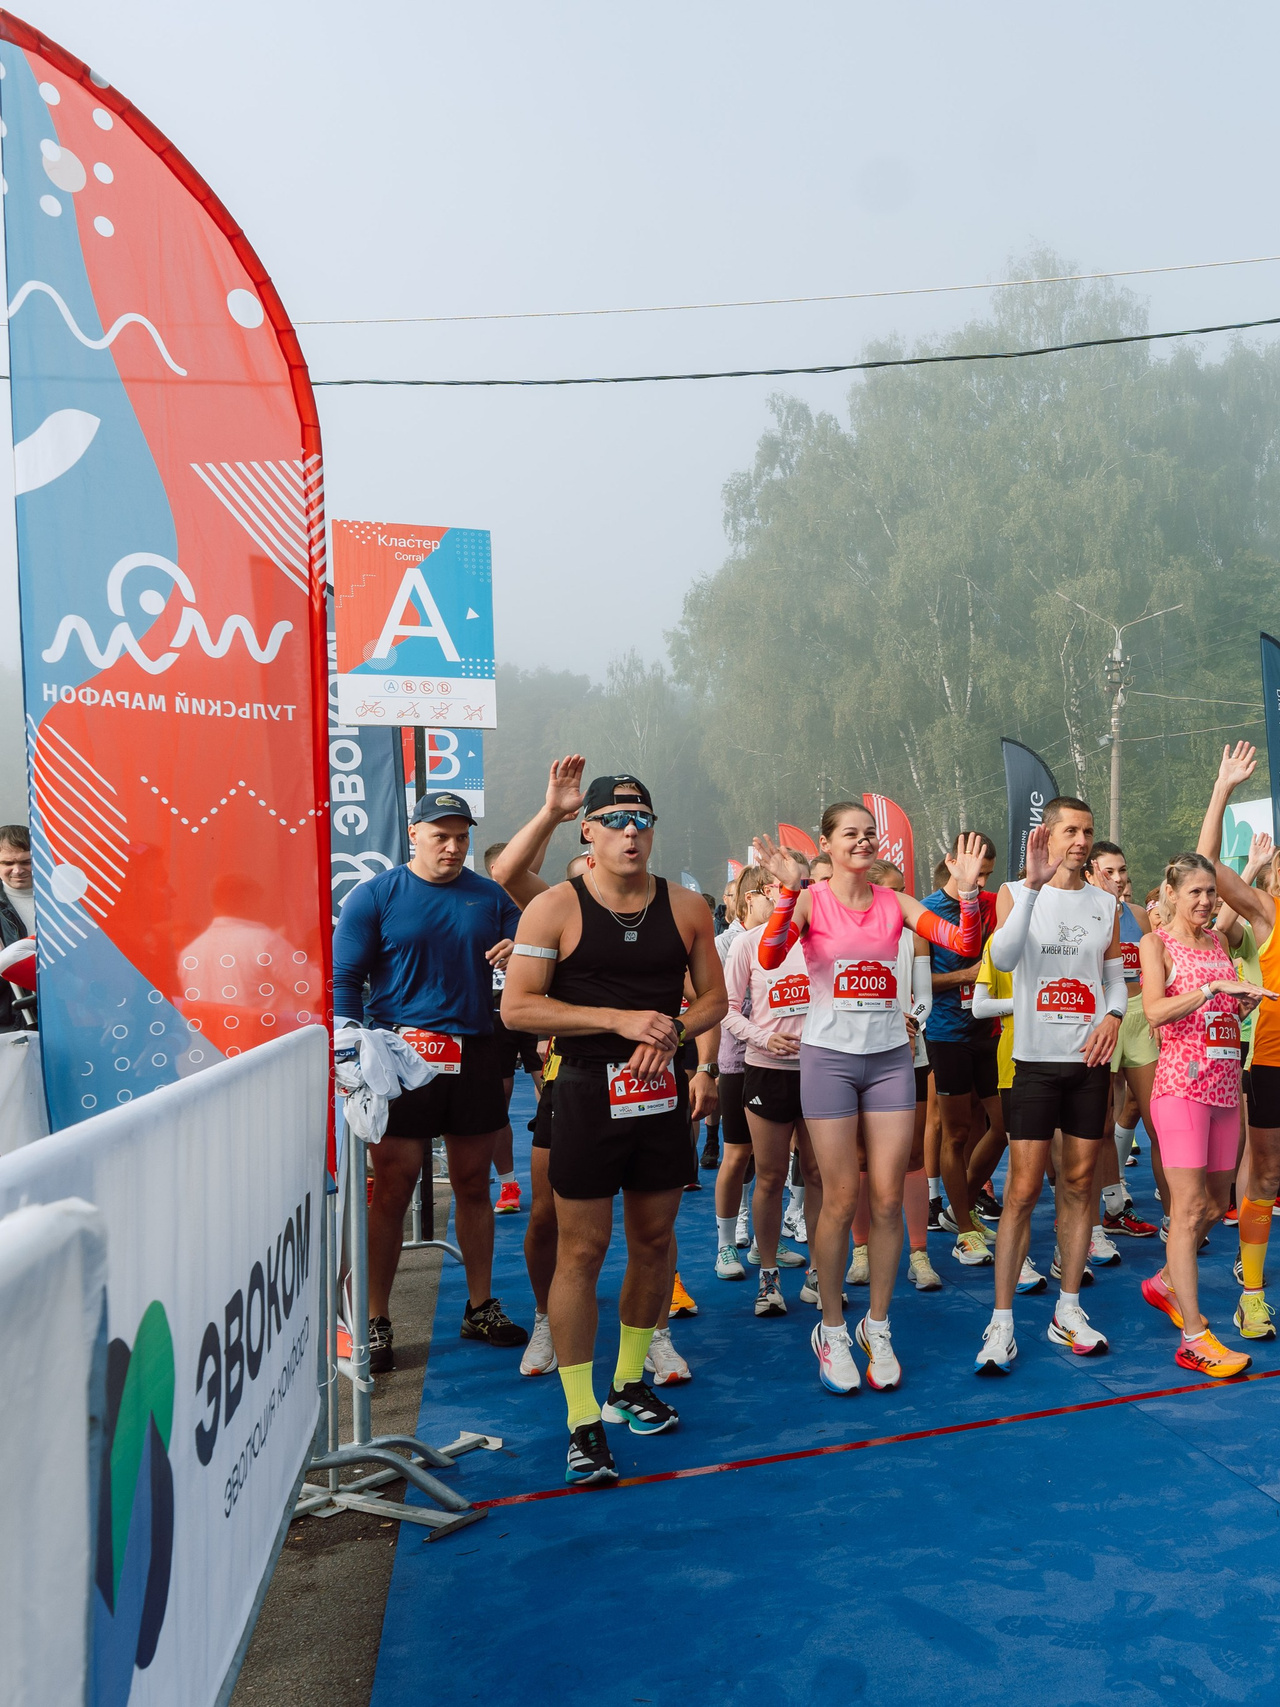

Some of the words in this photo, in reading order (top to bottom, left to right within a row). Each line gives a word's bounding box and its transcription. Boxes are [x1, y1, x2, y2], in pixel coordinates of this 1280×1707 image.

[377, 533, 441, 552] Кластер
[394, 551, 425, 562] Corral
[371, 567, 462, 662] A
[327, 631, 369, 837] ЭВОК
[424, 728, 461, 781] B
[1040, 945, 1061, 955] ЖИВЕЙ
[1062, 946, 1079, 956] БЕГИ!
[850, 975, 887, 990] 2008
[1052, 991, 1085, 1006] 2034
[1218, 1026, 1237, 1040] 2314
[628, 1074, 667, 1094] 2264
[195, 1191, 311, 1467] ЭВОКОМ
